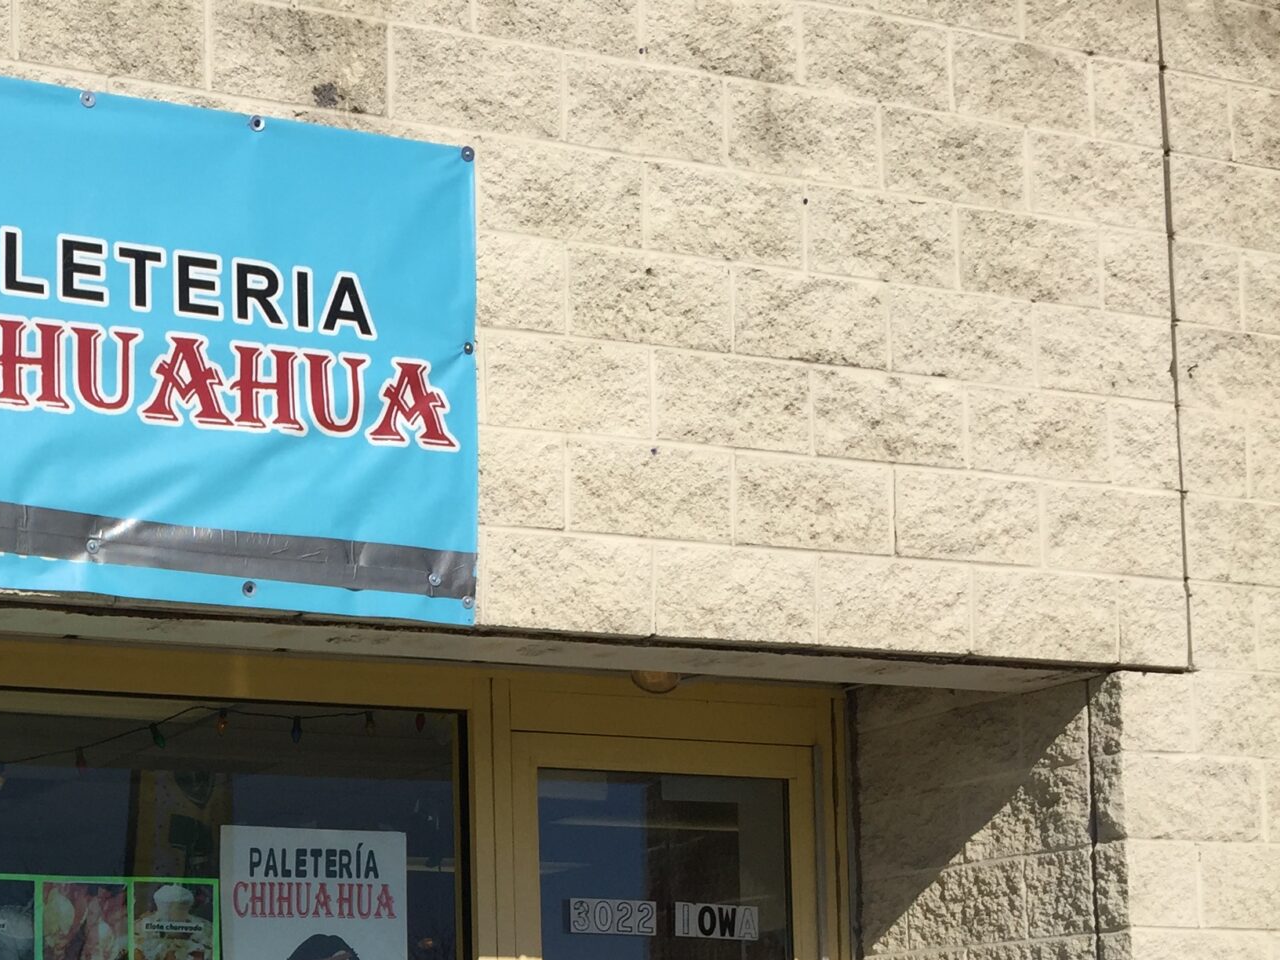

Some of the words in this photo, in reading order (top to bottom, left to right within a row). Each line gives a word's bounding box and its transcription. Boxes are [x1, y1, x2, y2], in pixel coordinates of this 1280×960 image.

[248, 842, 380, 879] PALETERÍA
[232, 880, 398, 920] CHIHUAHUA
[571, 899, 655, 934] 3022
[681, 903, 758, 939] IOWA
